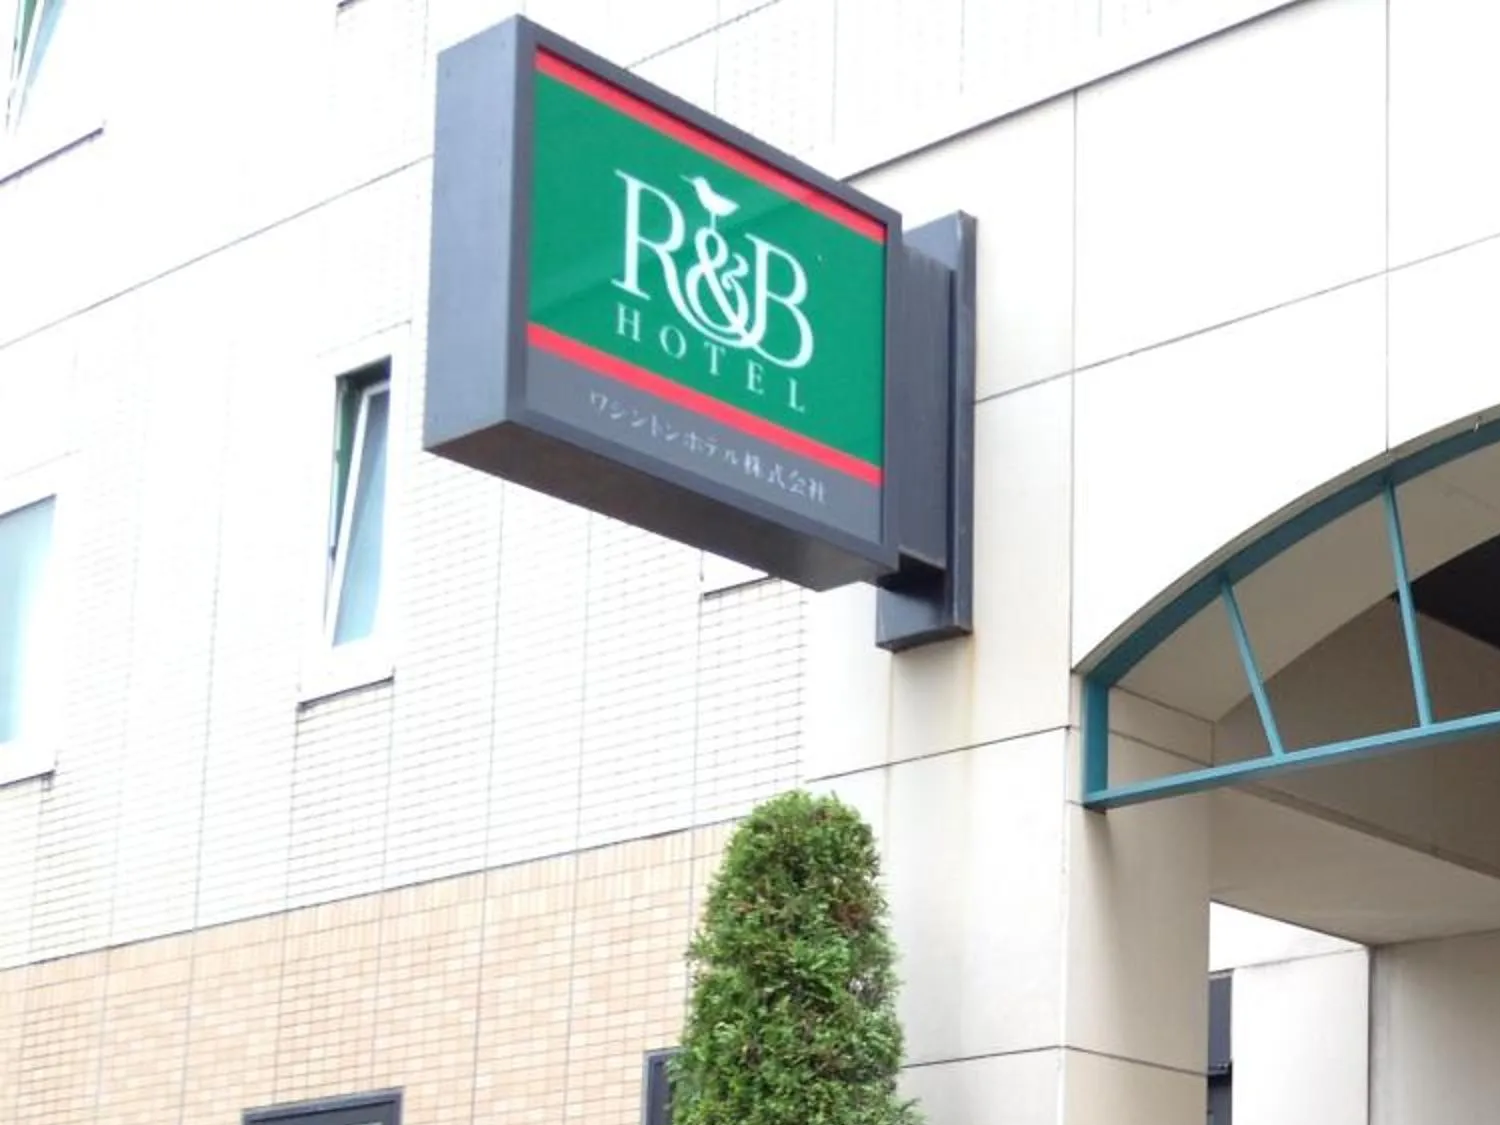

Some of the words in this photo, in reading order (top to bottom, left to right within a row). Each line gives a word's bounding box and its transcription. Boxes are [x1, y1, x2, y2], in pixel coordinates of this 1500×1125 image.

[611, 169, 814, 369] R&B
[616, 303, 806, 413] HOTEL
[590, 390, 825, 502] ワシントンホテル株式会社
